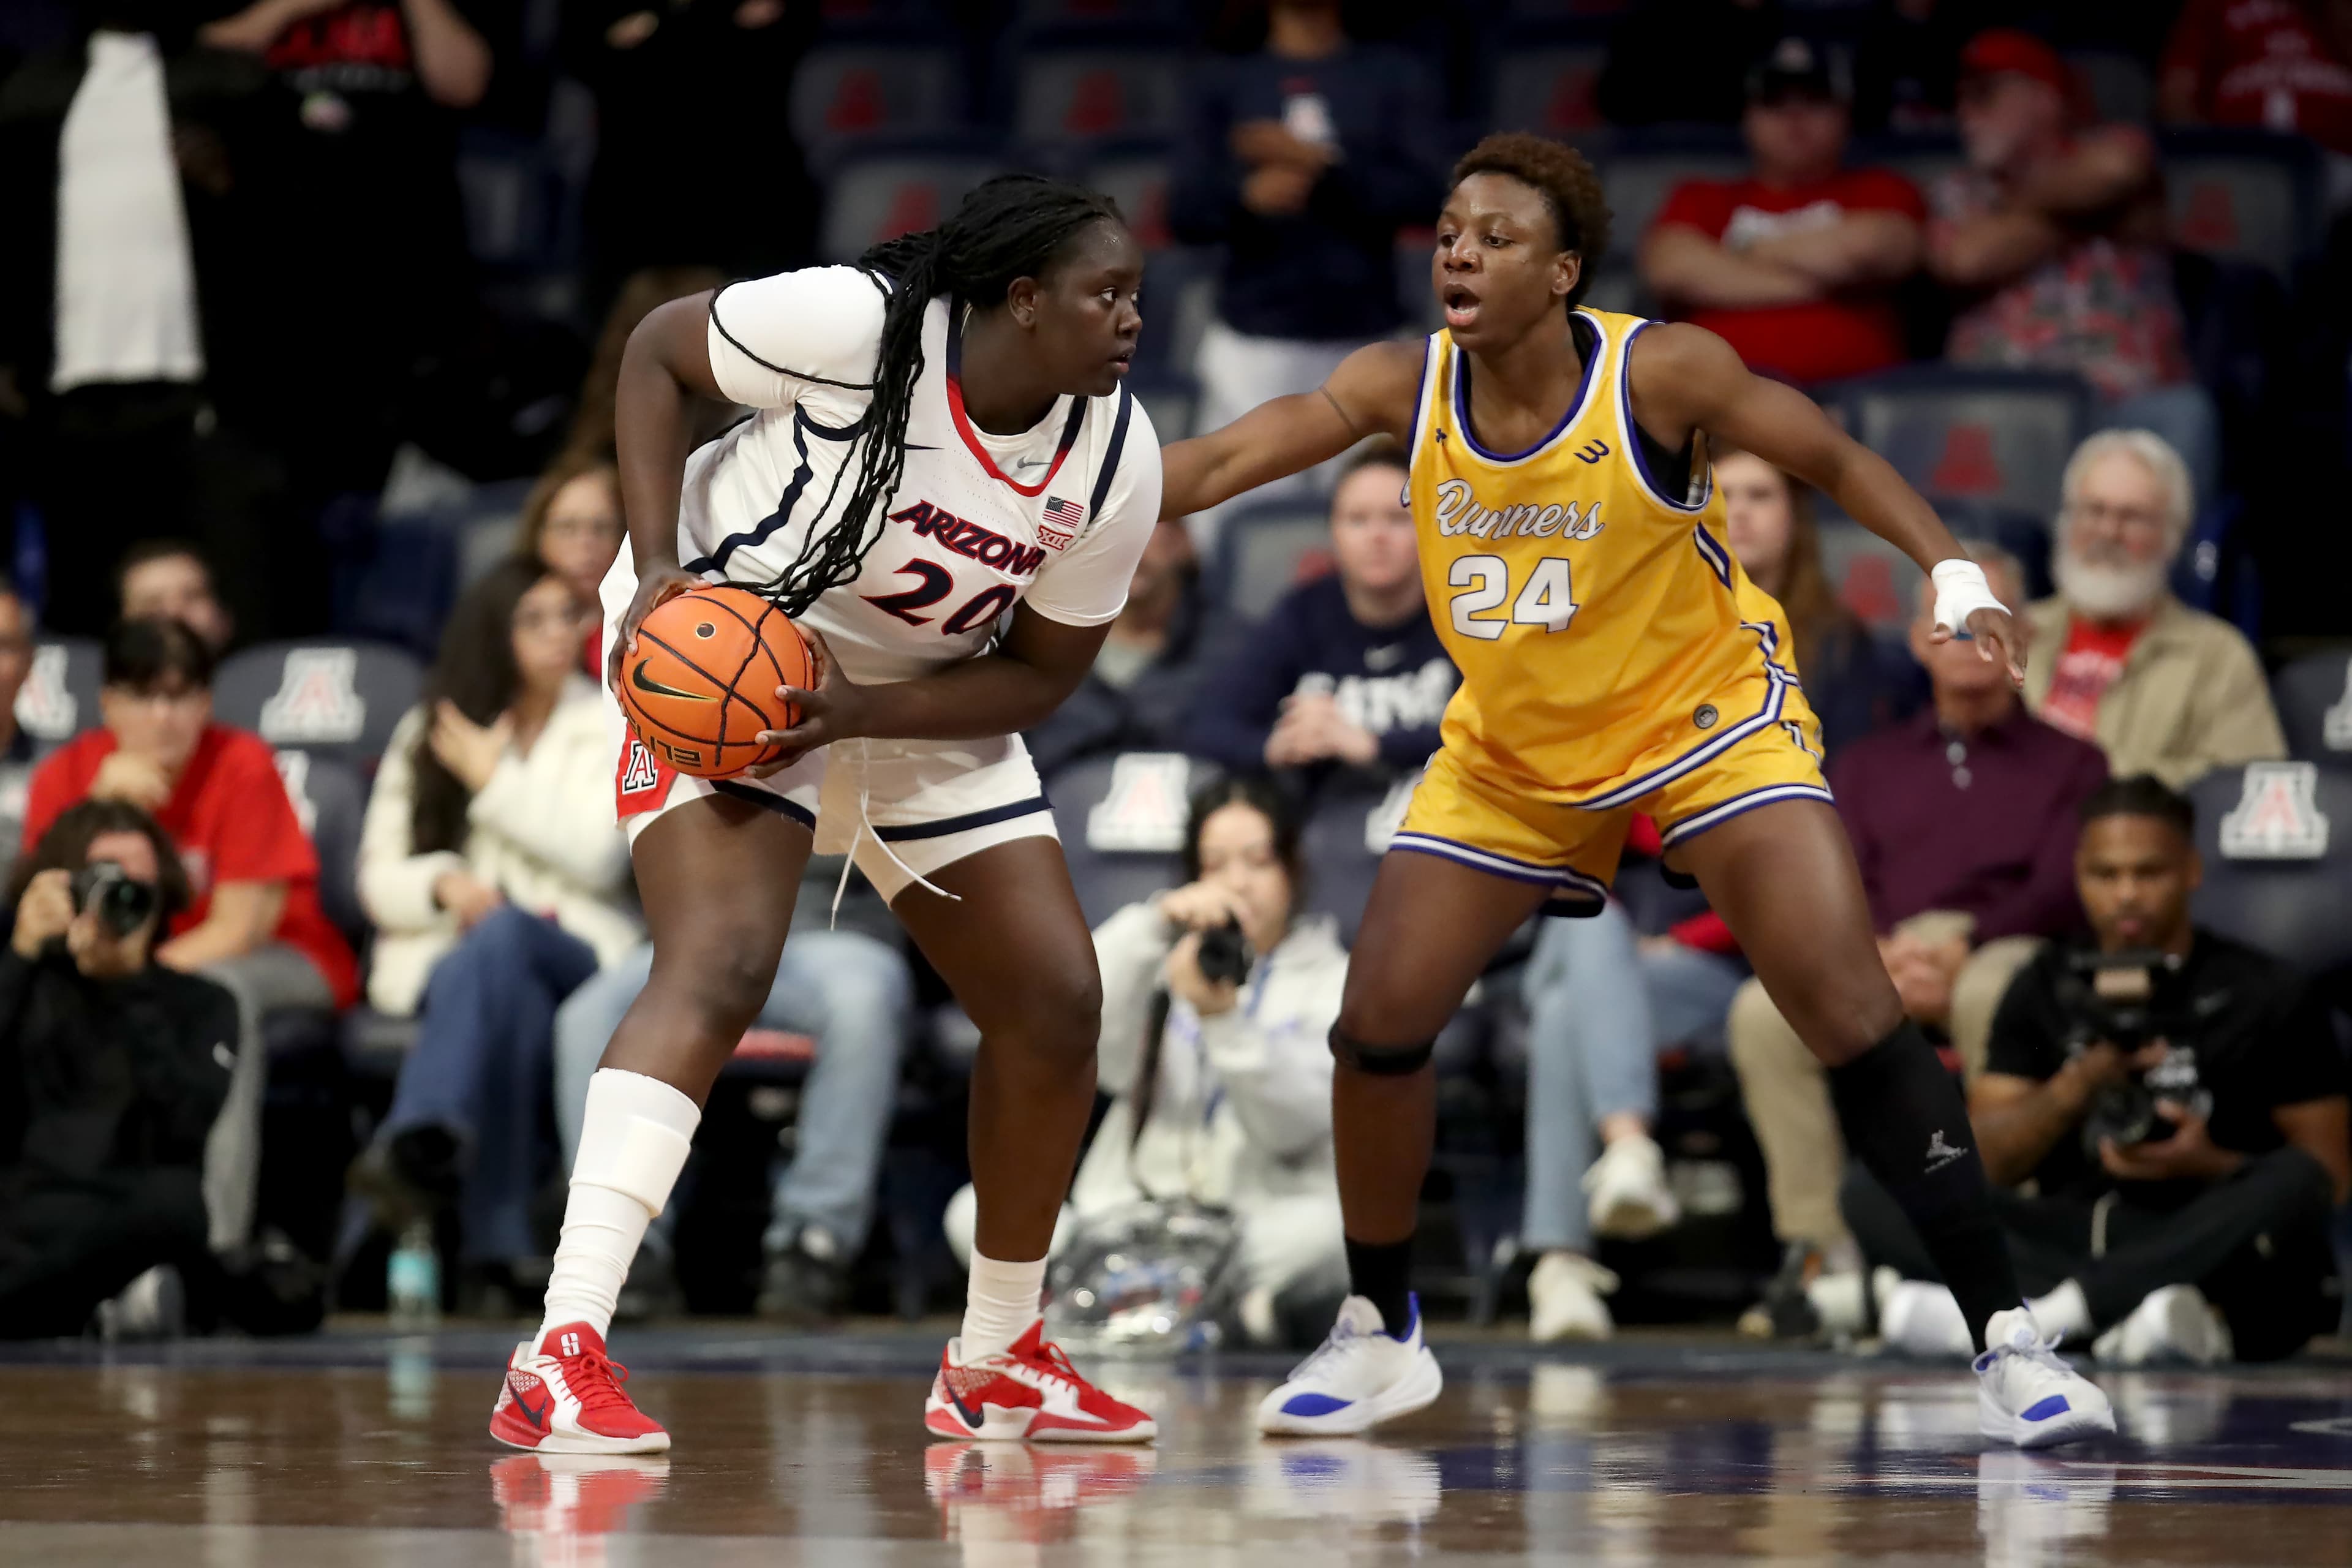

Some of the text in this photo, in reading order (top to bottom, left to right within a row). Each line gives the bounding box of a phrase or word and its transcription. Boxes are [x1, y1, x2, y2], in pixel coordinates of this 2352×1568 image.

[887, 499, 1046, 576] ARIZONA
[1436, 478, 1605, 540] Runners
[859, 558, 1016, 635] 20
[1448, 554, 1579, 641] 24
[259, 647, 366, 742] A
[622, 739, 658, 796] A
[2218, 760, 2329, 859] A
